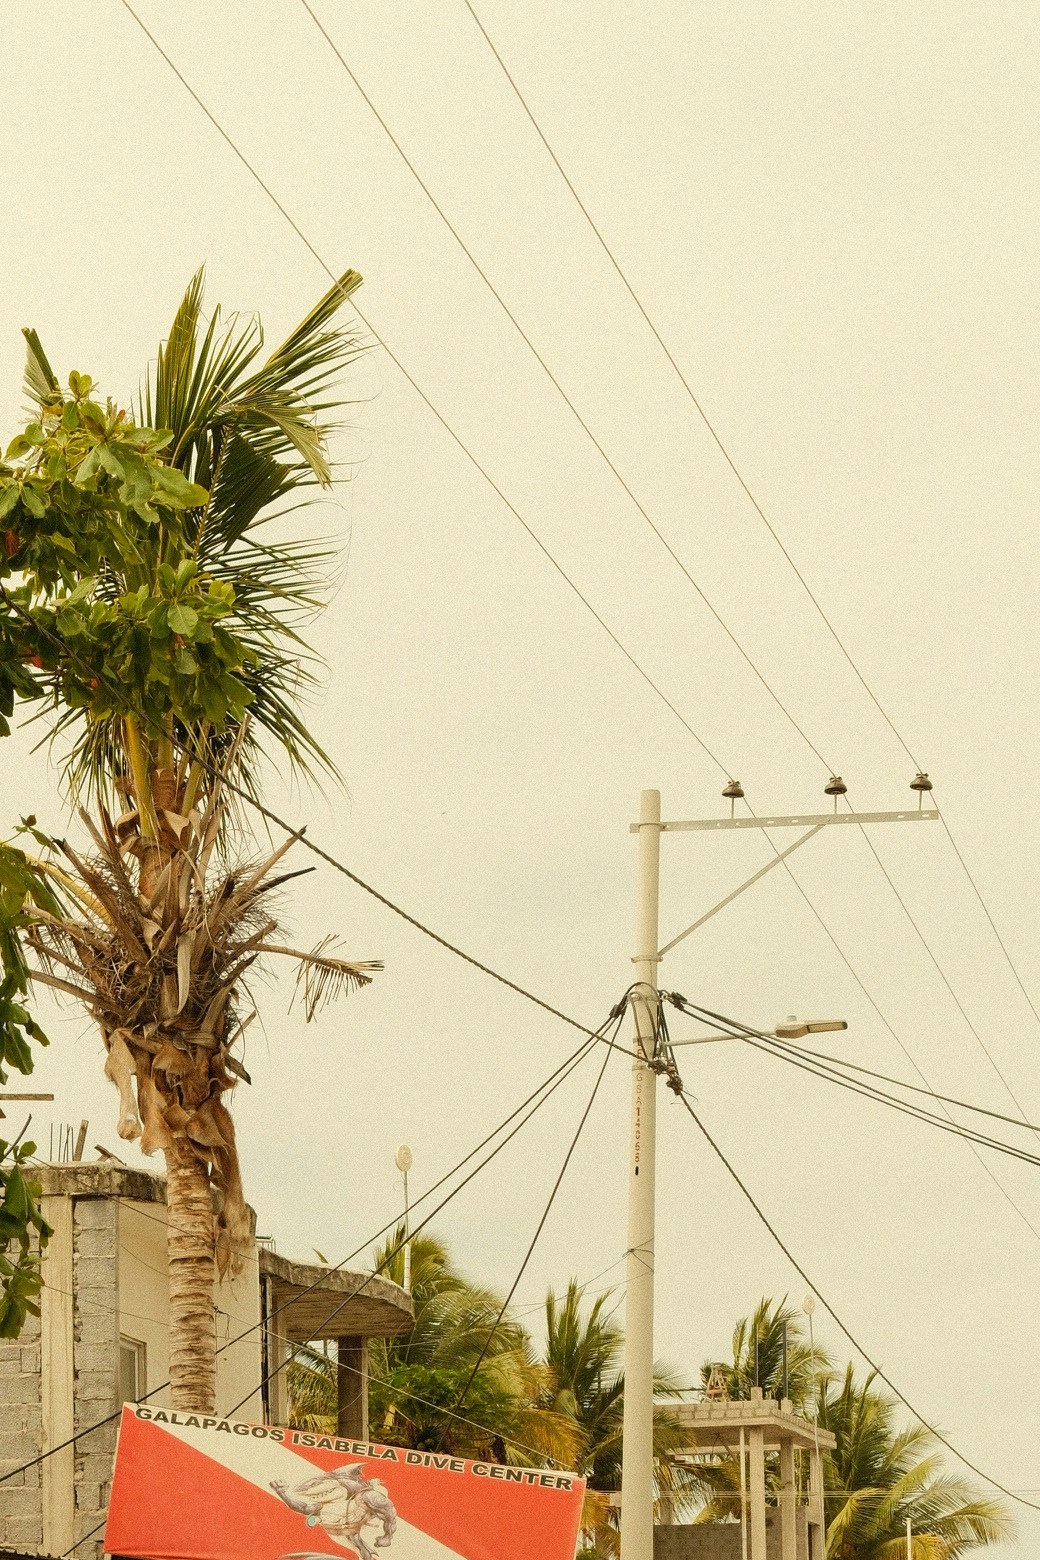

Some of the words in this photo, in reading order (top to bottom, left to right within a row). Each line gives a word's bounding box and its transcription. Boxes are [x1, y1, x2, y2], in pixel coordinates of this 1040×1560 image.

[135, 1407, 284, 1441] GALAPAGOS
[291, 1433, 398, 1461] ISABELA
[406, 1452, 464, 1473] DIVE
[471, 1464, 572, 1490] CENTER
